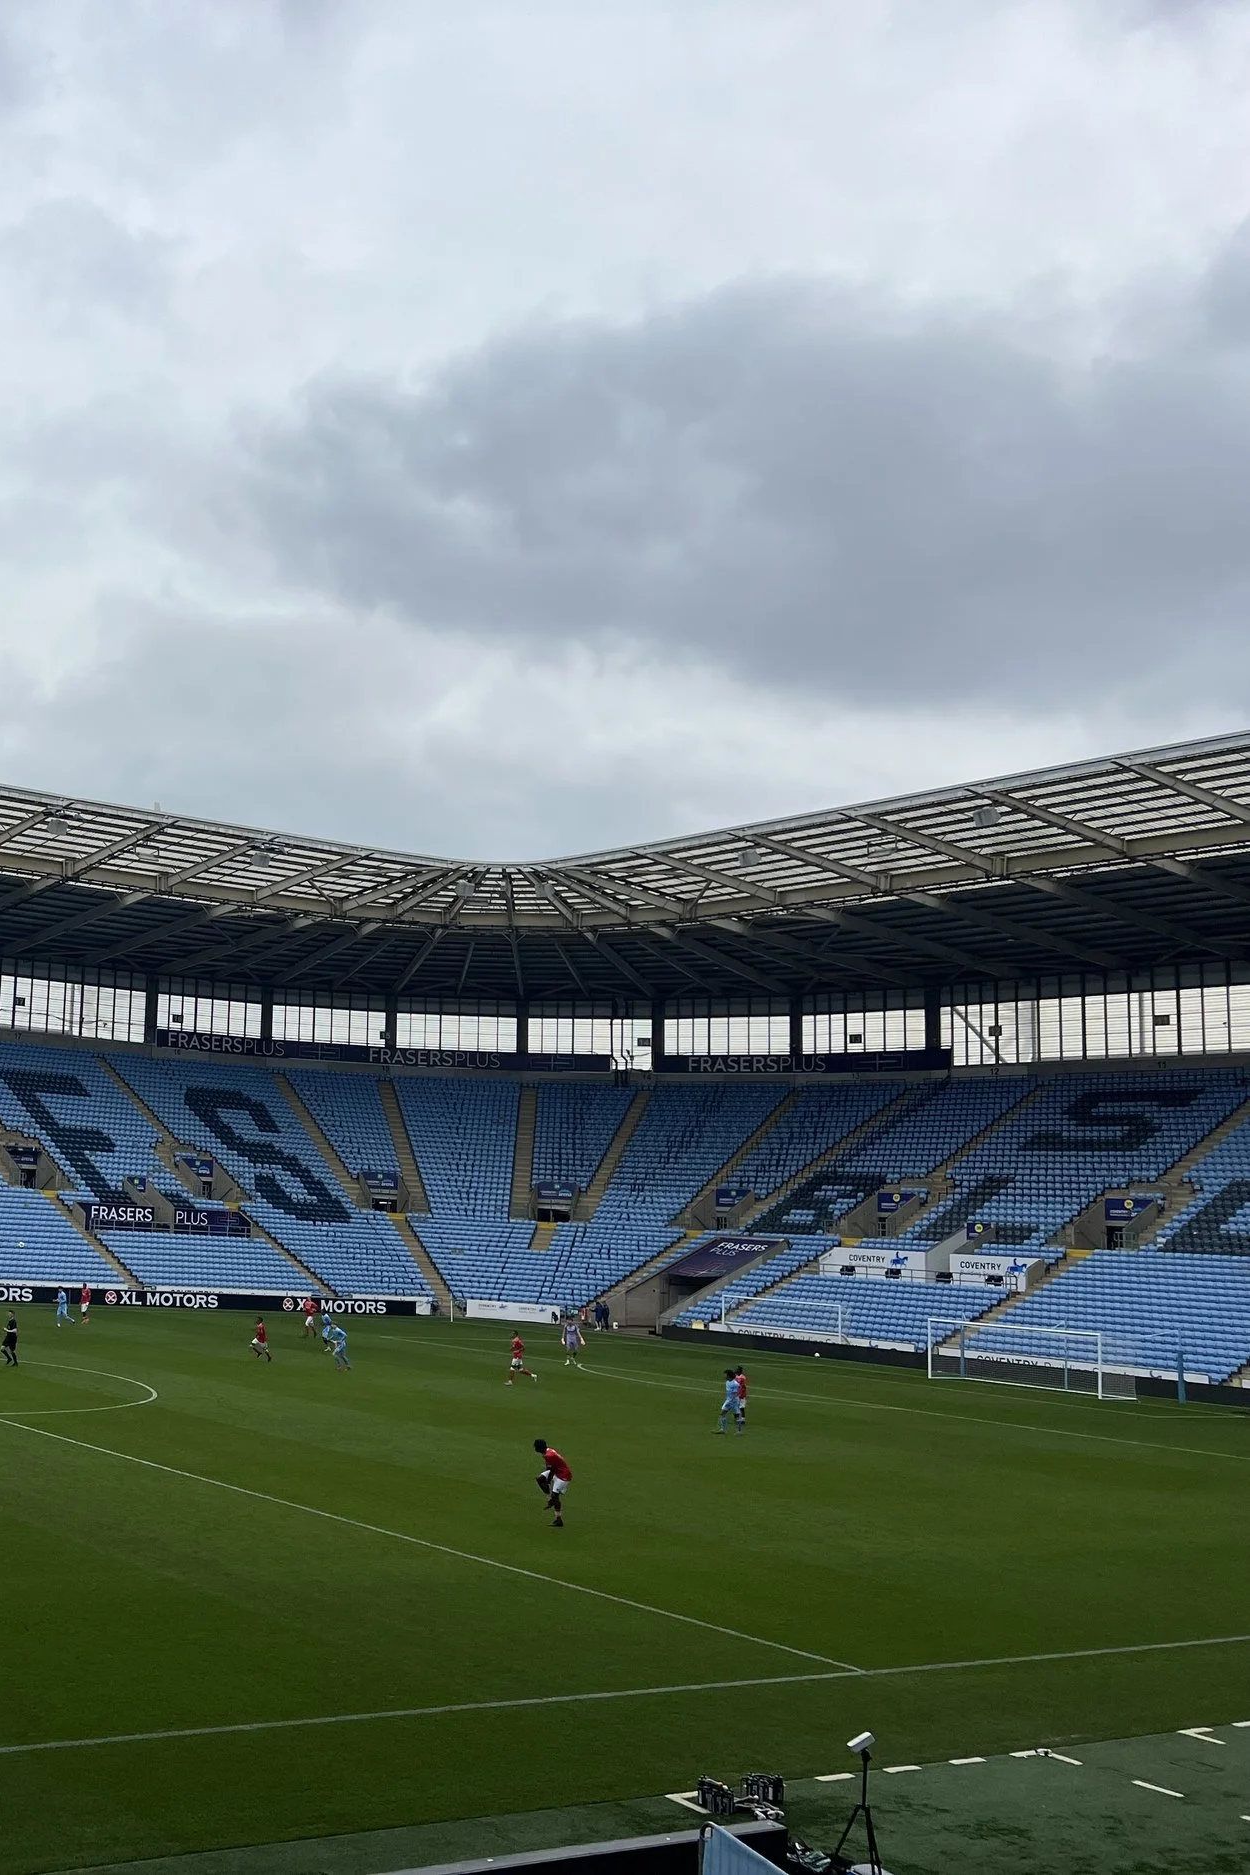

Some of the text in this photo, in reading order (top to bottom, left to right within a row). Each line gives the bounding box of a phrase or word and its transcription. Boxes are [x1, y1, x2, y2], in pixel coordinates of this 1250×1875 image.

[990, 1067, 999, 1076] 12
[91, 1205, 208, 1226] FRASERS PLUS
[710, 1247, 740, 1257] PLUS
[717, 1241, 769, 1252] FRASERS
[848, 1254, 886, 1263] COVENTRY
[960, 1260, 1002, 1271] COVENTRY
[119, 1291, 142, 1306] XL
[146, 1292, 219, 1309] MOTORS
[320, 1299, 387, 1314] MOTORS
